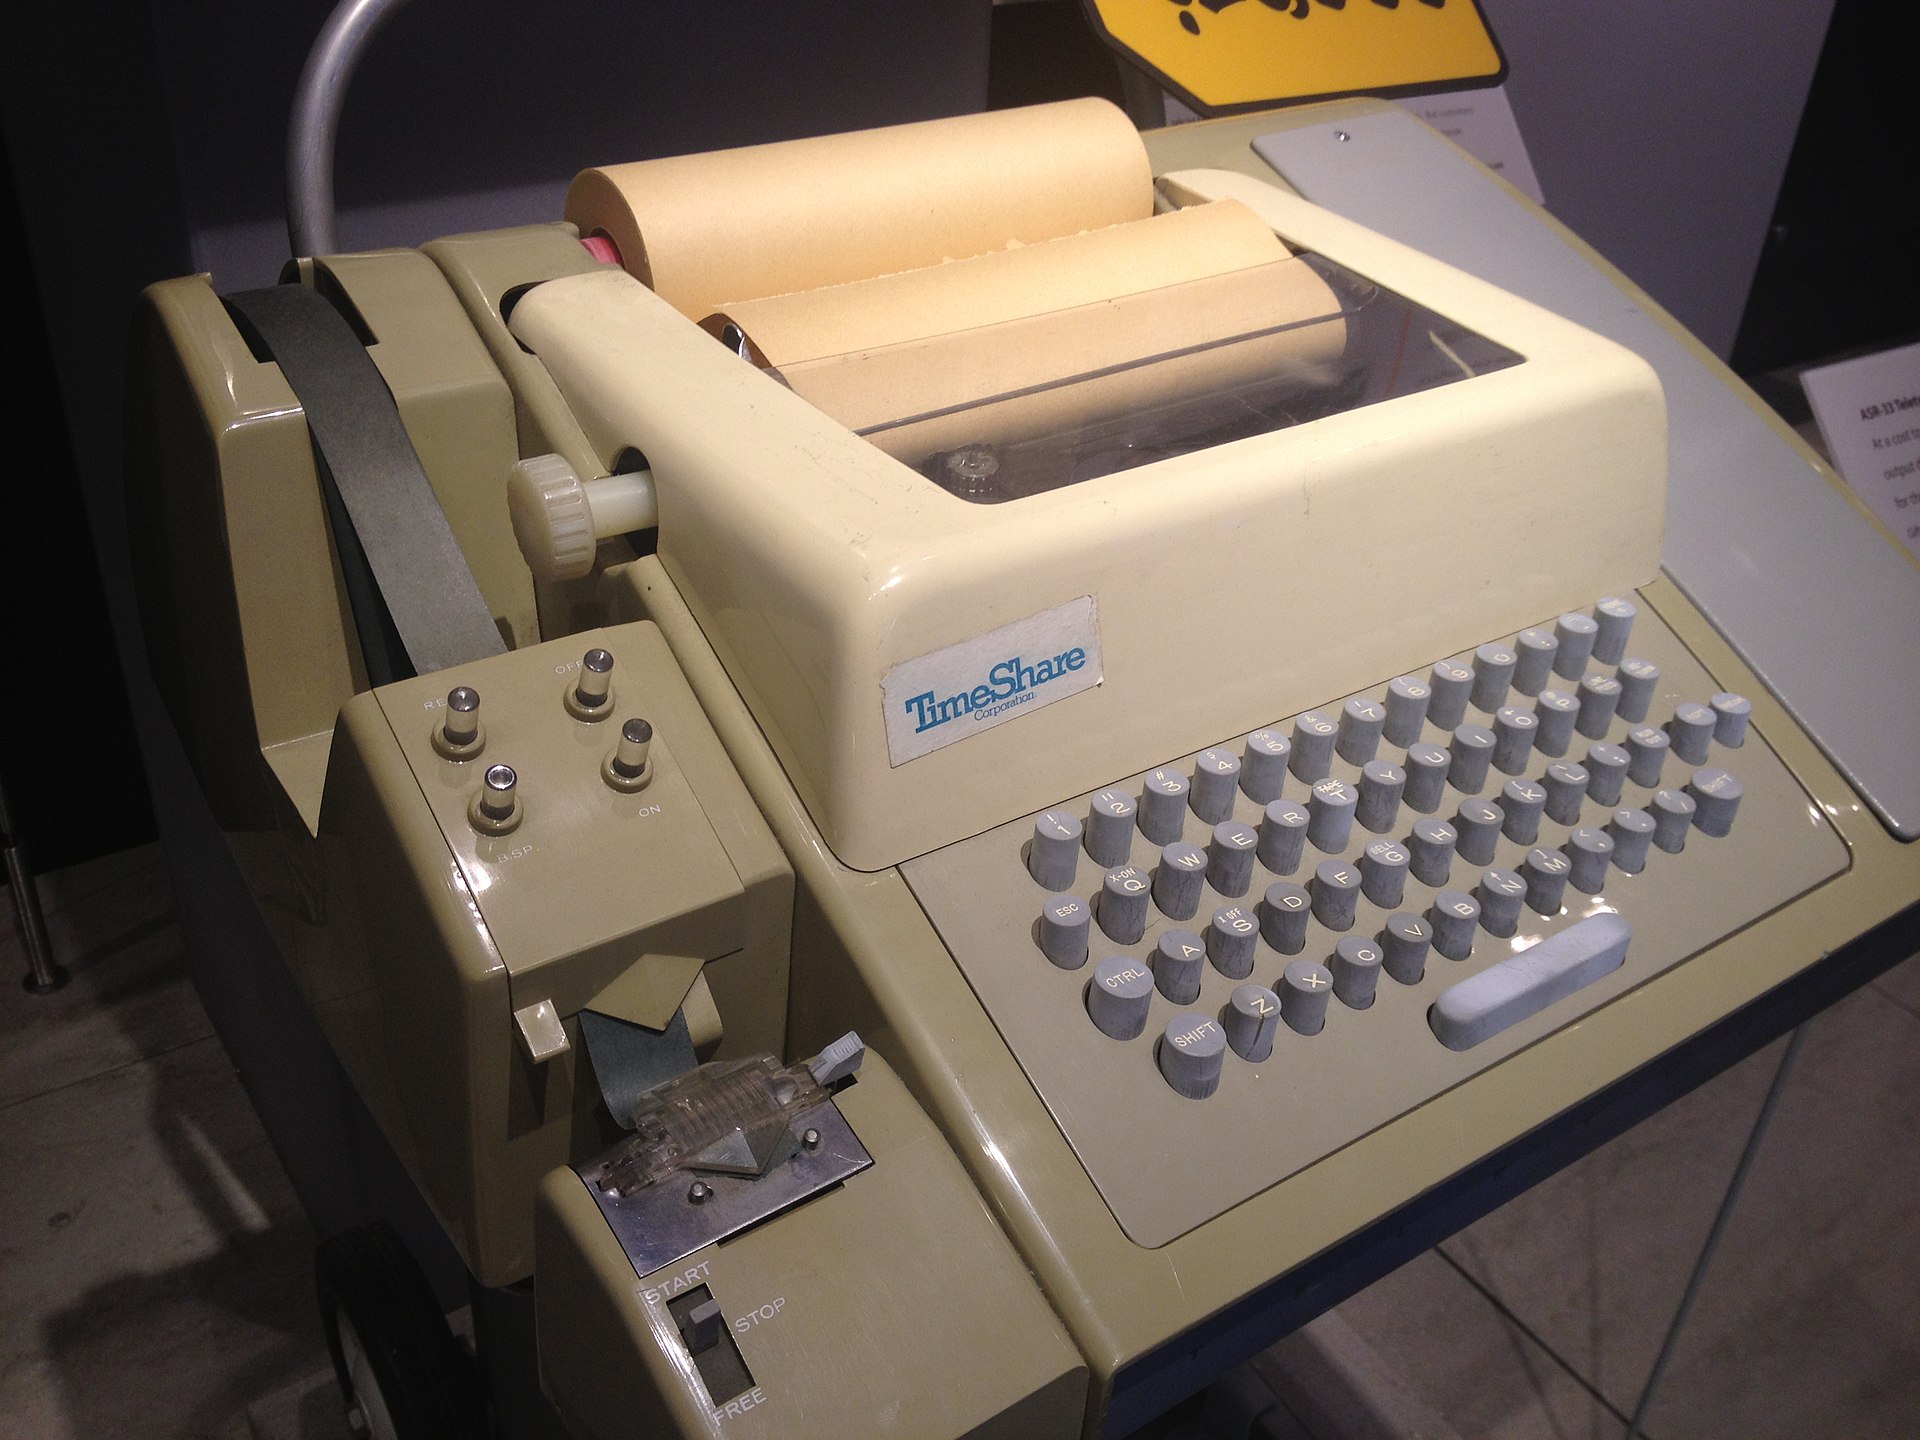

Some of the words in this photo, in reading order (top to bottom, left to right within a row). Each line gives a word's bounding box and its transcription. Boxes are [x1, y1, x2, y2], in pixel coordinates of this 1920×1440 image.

[1860, 402, 1895, 420] ASR-33
[1451, 669, 1469, 679] 9
[904, 647, 1086, 734] TimeShare
[1407, 686, 1425, 696] 8
[1556, 698, 1570, 709] P
[1360, 707, 1376, 718] 7
[1315, 722, 1332, 733] 6
[1515, 716, 1532, 726] O
[1266, 741, 1284, 752] 5
[1425, 752, 1445, 763] U
[1218, 761, 1233, 770] 4
[1156, 770, 1165, 781] #
[1380, 770, 1397, 780] Y
[1565, 772, 1586, 782] L
[1162, 781, 1182, 792] 3
[1329, 789, 1348, 801] T
[1520, 789, 1543, 801] K
[638, 804, 662, 817] ON
[1111, 802, 1130, 814] 2
[1282, 811, 1304, 824] R
[1482, 809, 1497, 821] J
[1058, 825, 1071, 836] 1
[1430, 828, 1453, 841] H
[1231, 832, 1253, 846] E
[1370, 841, 1395, 856] BELL
[1178, 853, 1201, 868] W
[1385, 851, 1404, 862] G
[1543, 858, 1568, 872] M
[1109, 867, 1136, 883] X-ON
[1334, 871, 1349, 885] F
[1123, 879, 1146, 892] Q
[1501, 880, 1523, 893] N
[1283, 896, 1303, 909] D
[1056, 903, 1079, 917] ESC
[1454, 903, 1475, 916] B
[1232, 919, 1253, 932] S
[1404, 924, 1423, 937] V
[1181, 944, 1201, 958] A
[1357, 950, 1376, 961] C
[1105, 967, 1145, 989] CTRL
[1302, 973, 1327, 988] X
[1250, 998, 1274, 1014] Z
[1174, 1020, 1217, 1048] SHIFT
[644, 1260, 712, 1305] START
[734, 1296, 786, 1333] STOP
[712, 1387, 768, 1427] FREE
